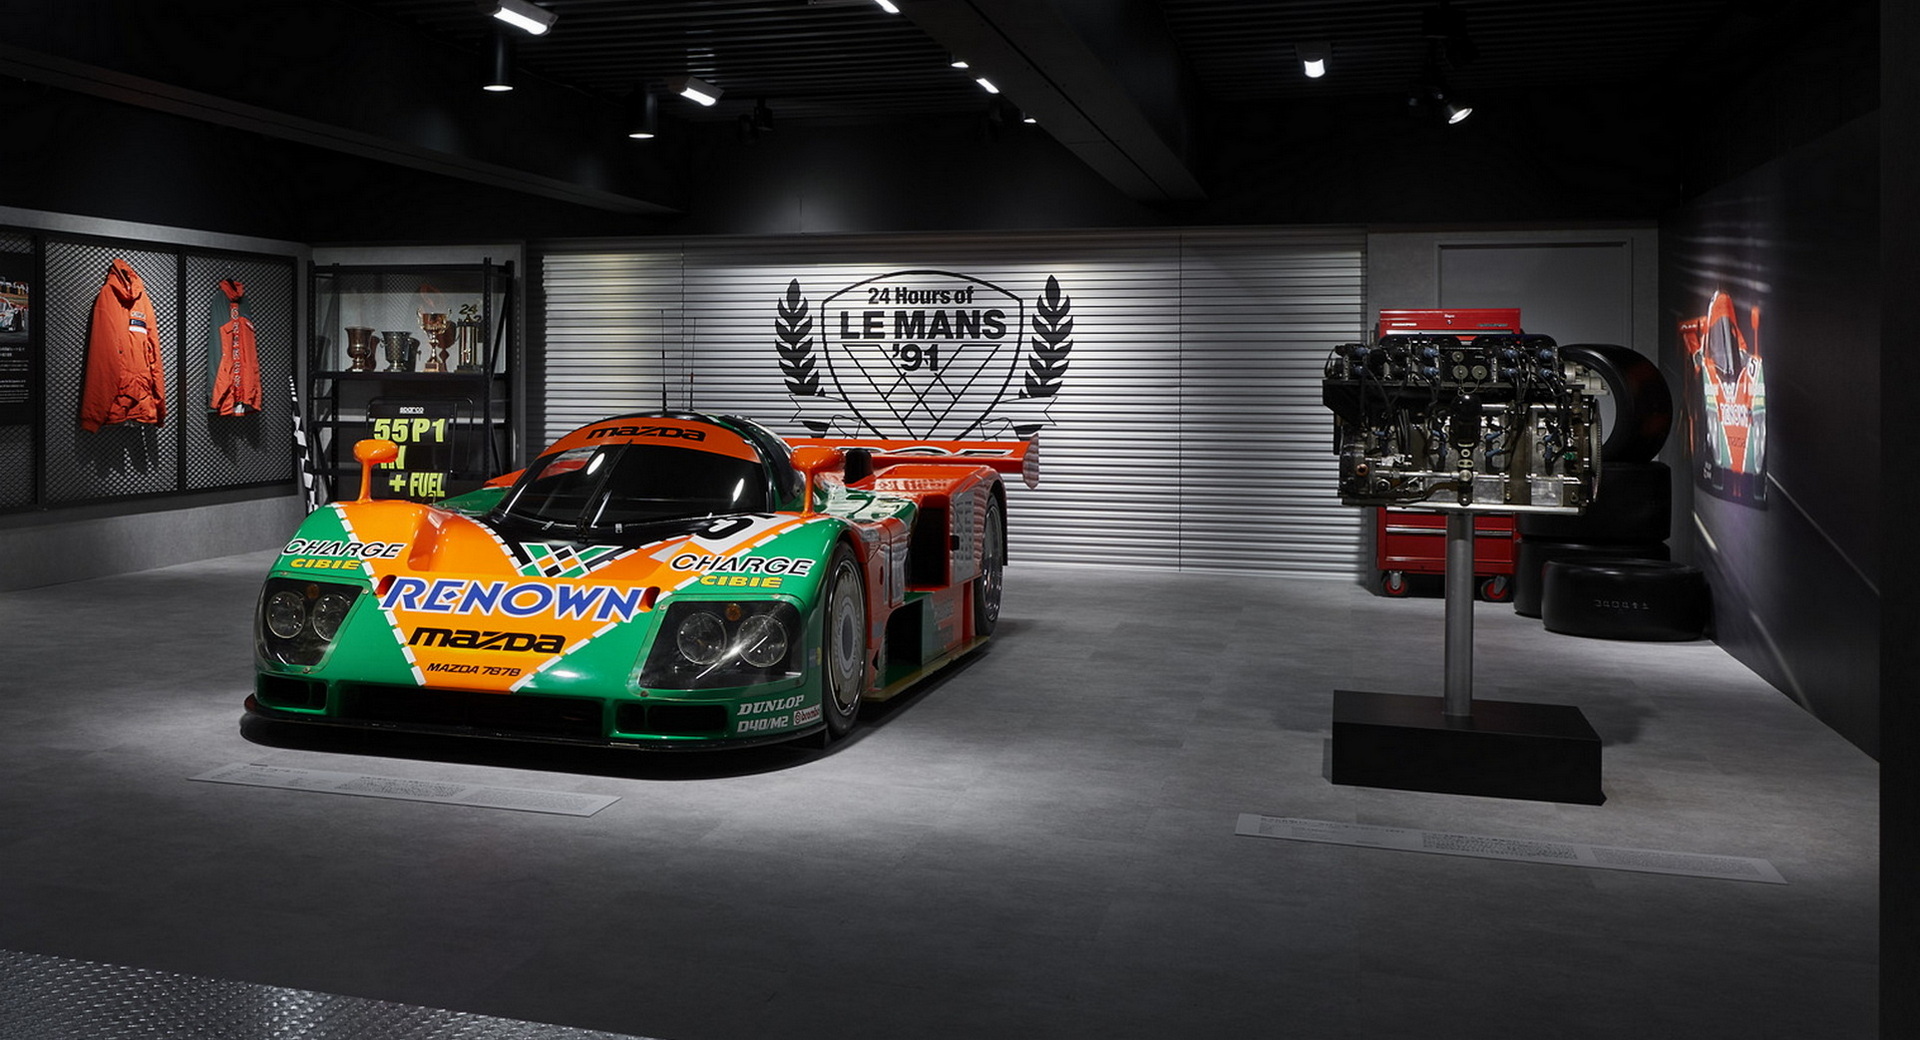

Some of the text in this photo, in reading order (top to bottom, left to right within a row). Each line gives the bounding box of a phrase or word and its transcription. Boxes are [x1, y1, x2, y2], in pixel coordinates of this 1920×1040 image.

[868, 286, 974, 304] 24 Hours of
[840, 310, 1006, 340] LE MANS
[892, 343, 939, 371] '91
[586, 426, 706, 442] mazda
[409, 472, 445, 498] FUEL
[282, 539, 406, 559] CHARGE
[290, 558, 361, 570] CIBIE
[671, 553, 815, 577] CHARGE
[700, 575, 782, 589] CIBIE
[379, 576, 643, 622] RENOWN
[408, 627, 567, 654] mazda
[426, 662, 522, 677] MAZDA 787B
[737, 695, 804, 716] DUNLOP
[737, 716, 788, 732] D40/M2
